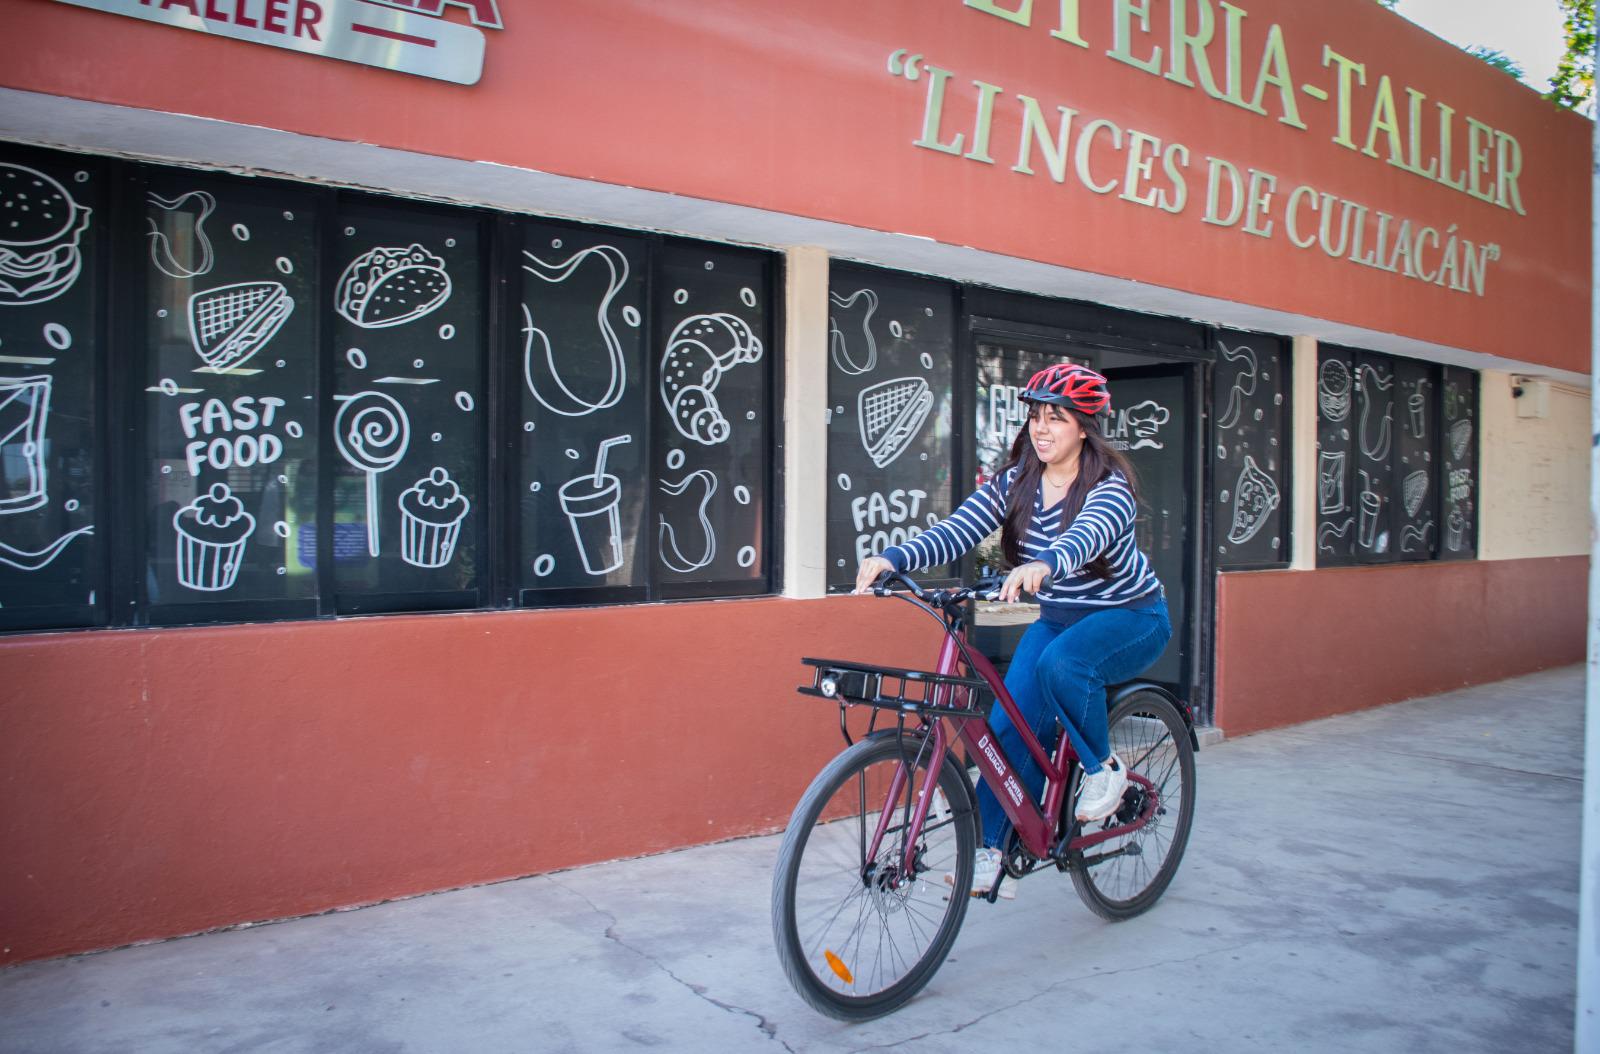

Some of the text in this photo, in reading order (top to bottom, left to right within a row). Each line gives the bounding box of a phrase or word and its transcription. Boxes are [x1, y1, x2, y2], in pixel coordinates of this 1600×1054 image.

[138, 0, 321, 42] LLER
[964, 0, 1527, 216] ERIA-TALLER
[1200, 156, 1278, 239] DE
[179, 395, 286, 439] FAST
[185, 433, 283, 477] FOOD
[851, 488, 928, 532] FAST
